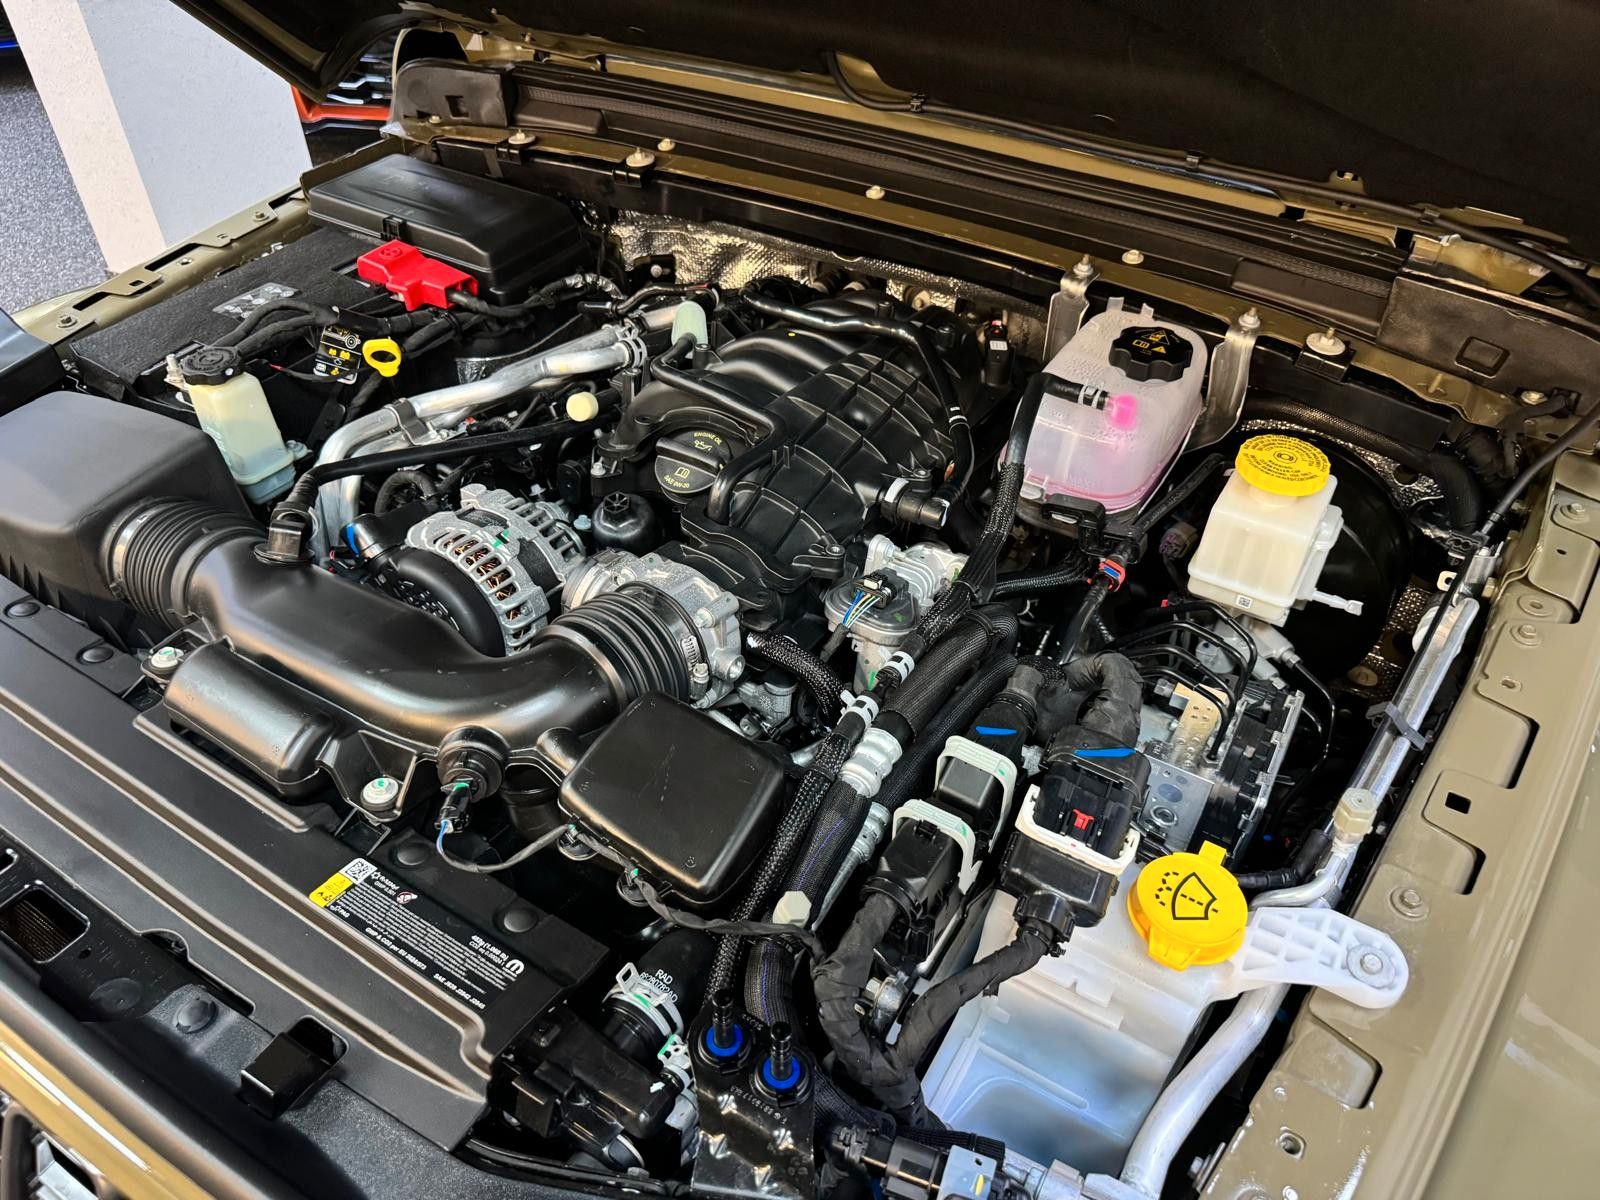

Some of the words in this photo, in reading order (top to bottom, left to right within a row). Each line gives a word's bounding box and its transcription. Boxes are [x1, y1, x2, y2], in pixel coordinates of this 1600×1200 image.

[694, 432, 715, 440] ENGINE
[434, 974, 446, 983] SAE
[655, 968, 673, 985] RAD
